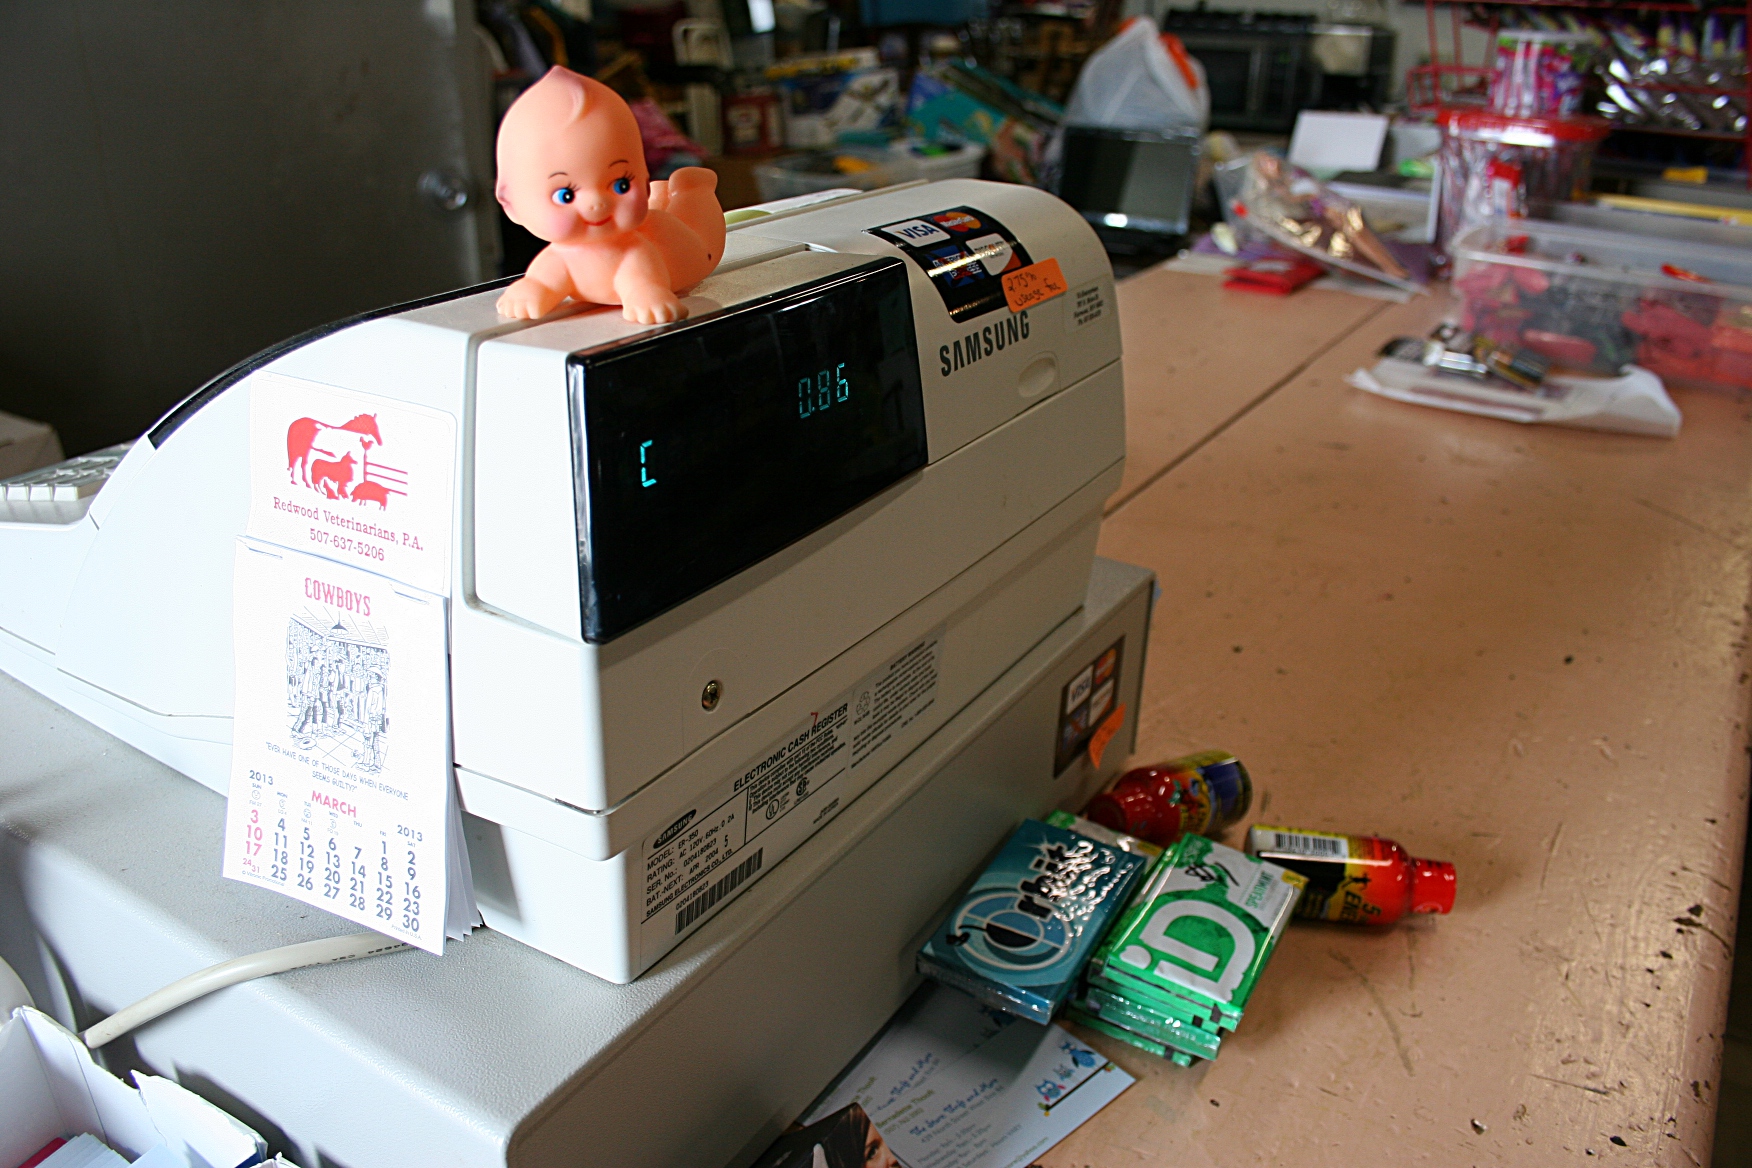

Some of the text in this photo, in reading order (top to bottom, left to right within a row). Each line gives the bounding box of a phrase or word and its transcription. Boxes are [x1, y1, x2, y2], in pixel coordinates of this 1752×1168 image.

[897, 224, 940, 240] VISA
[939, 311, 1030, 377] SAMSUNG
[799, 362, 849, 419] 0.86
[273, 497, 424, 551] Redwood Veterinarians, P.A.
[309, 528, 385, 561] 507-637-5206
[304, 577, 371, 617] COWBOYS
[733, 747, 786, 793] ELECTRONIC
[788, 729, 810, 753] CASH
[811, 703, 848, 737] REGISTER
[249, 769, 273, 785] 2013
[282, 748, 296, 760] HAVE
[298, 754, 310, 764] ONE
[312, 759, 319, 767] OF
[322, 762, 340, 776] THOSE
[342, 770, 357, 782] DAYS
[360, 776, 377, 789] WHEN
[379, 783, 408, 801] EVERYONE
[312, 770, 330, 783] SEEMS
[311, 790, 356, 818] MARCH
[353, 820, 362, 828] THU
[397, 824, 423, 842] 2013
[657, 812, 693, 844] SAMSUNG
[250, 809, 416, 881] 3 4 5 6 7 8 9
[382, 840, 416, 866] 1 2
[647, 829, 699, 871] MODEL: ER-350
[724, 834, 729, 848] 5
[242, 857, 252, 867] 24
[245, 840, 420, 916] 17 18 19 20 21 22 23
[247, 824, 421, 900] 10 11 12 13 14 15 16
[252, 864, 260, 873] 31
[646, 847, 719, 906] BAT.-NEXT: APR 2004
[647, 858, 675, 882] RATING:
[679, 849, 687, 859] AC
[646, 879, 662, 894] SER.
[664, 868, 678, 881] No.:
[646, 894, 674, 917] SAMSUNG
[674, 866, 710, 896] ELECTRONICS
[271, 864, 420, 933] 25 26 27 28 29 30
